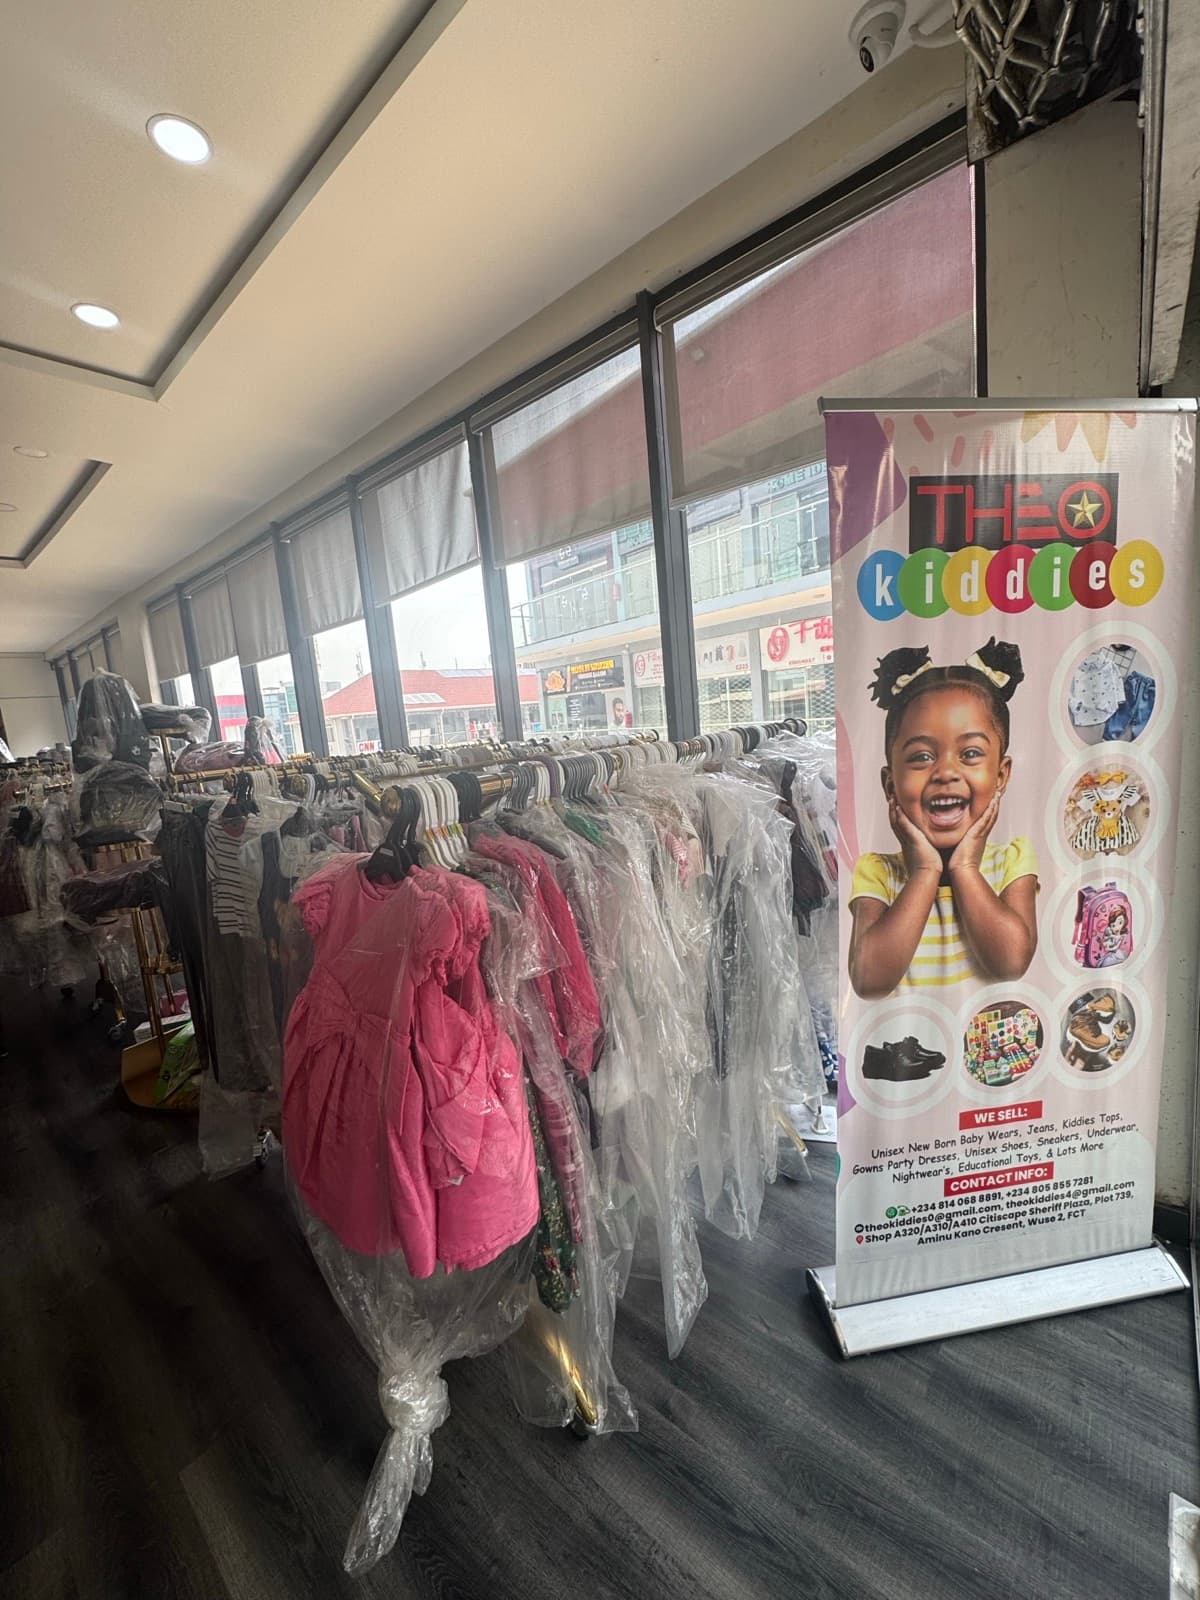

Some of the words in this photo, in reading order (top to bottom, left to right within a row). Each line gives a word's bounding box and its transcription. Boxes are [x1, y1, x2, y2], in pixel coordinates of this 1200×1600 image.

[916, 480, 1112, 545] THEO
[873, 555, 1147, 608] kiddies
[974, 1111, 995, 1124] WE
[997, 1107, 1028, 1121] SELL:
[852, 1164, 884, 1176] Gowns
[887, 1158, 914, 1171] Party
[918, 1151, 960, 1166] Dresses,
[965, 1145, 998, 1158] Unisex
[1001, 1140, 1032, 1153] Shoes,
[1037, 1132, 1082, 1147] Sneakers,
[1087, 1123, 1139, 1139] Underwear,
[871, 1147, 905, 1160] Unisex
[908, 1142, 930, 1154] New
[934, 1139, 957, 1150] Born
[960, 1133, 984, 1146] Baby
[988, 1128, 1022, 1141] Wears,
[1027, 1124, 1058, 1136] Jeans,
[1062, 1115, 1096, 1130] Kiddies
[1099, 1112, 1123, 1124] Tops,
[958, 1155, 1013, 1173] Educational
[1016, 1151, 1042, 1164] Toys,
[1046, 1148, 1053, 1159] &
[1057, 1144, 1077, 1157] Lots
[1080, 1141, 1105, 1153] More
[911, 1202, 936, 1214] +234
[938, 1199, 956, 1211] 814
[957, 1195, 977, 1207] 068
[1006, 1186, 1030, 1198] +234
[1032, 1182, 1051, 1194] 805
[1053, 1179, 1072, 1191] 855
[1073, 1175, 1094, 1187] 7281
[950, 1172, 1013, 1192] CONTACT
[1014, 1166, 1048, 1182] INFO:
[1006, 1180, 1135, 1209] theokiddies4@gmail.com
[865, 1231, 892, 1244] Shop
[894, 1217, 977, 1239] A320/A310/A410
[979, 1210, 1027, 1224] Citiscape
[1029, 1201, 1062, 1216] Sheriff
[1063, 1196, 1093, 1209] Plaza,
[1095, 1193, 1114, 1205] Plot
[1115, 1189, 1134, 1201] 739,
[917, 1232, 952, 1246] Aminu
[954, 1227, 981, 1240] Kano
[983, 1219, 1026, 1234] Cresent,
[1027, 1214, 1056, 1227] Wuse
[1057, 1212, 1066, 1223] 2,
[1068, 1208, 1087, 1220] FCT
